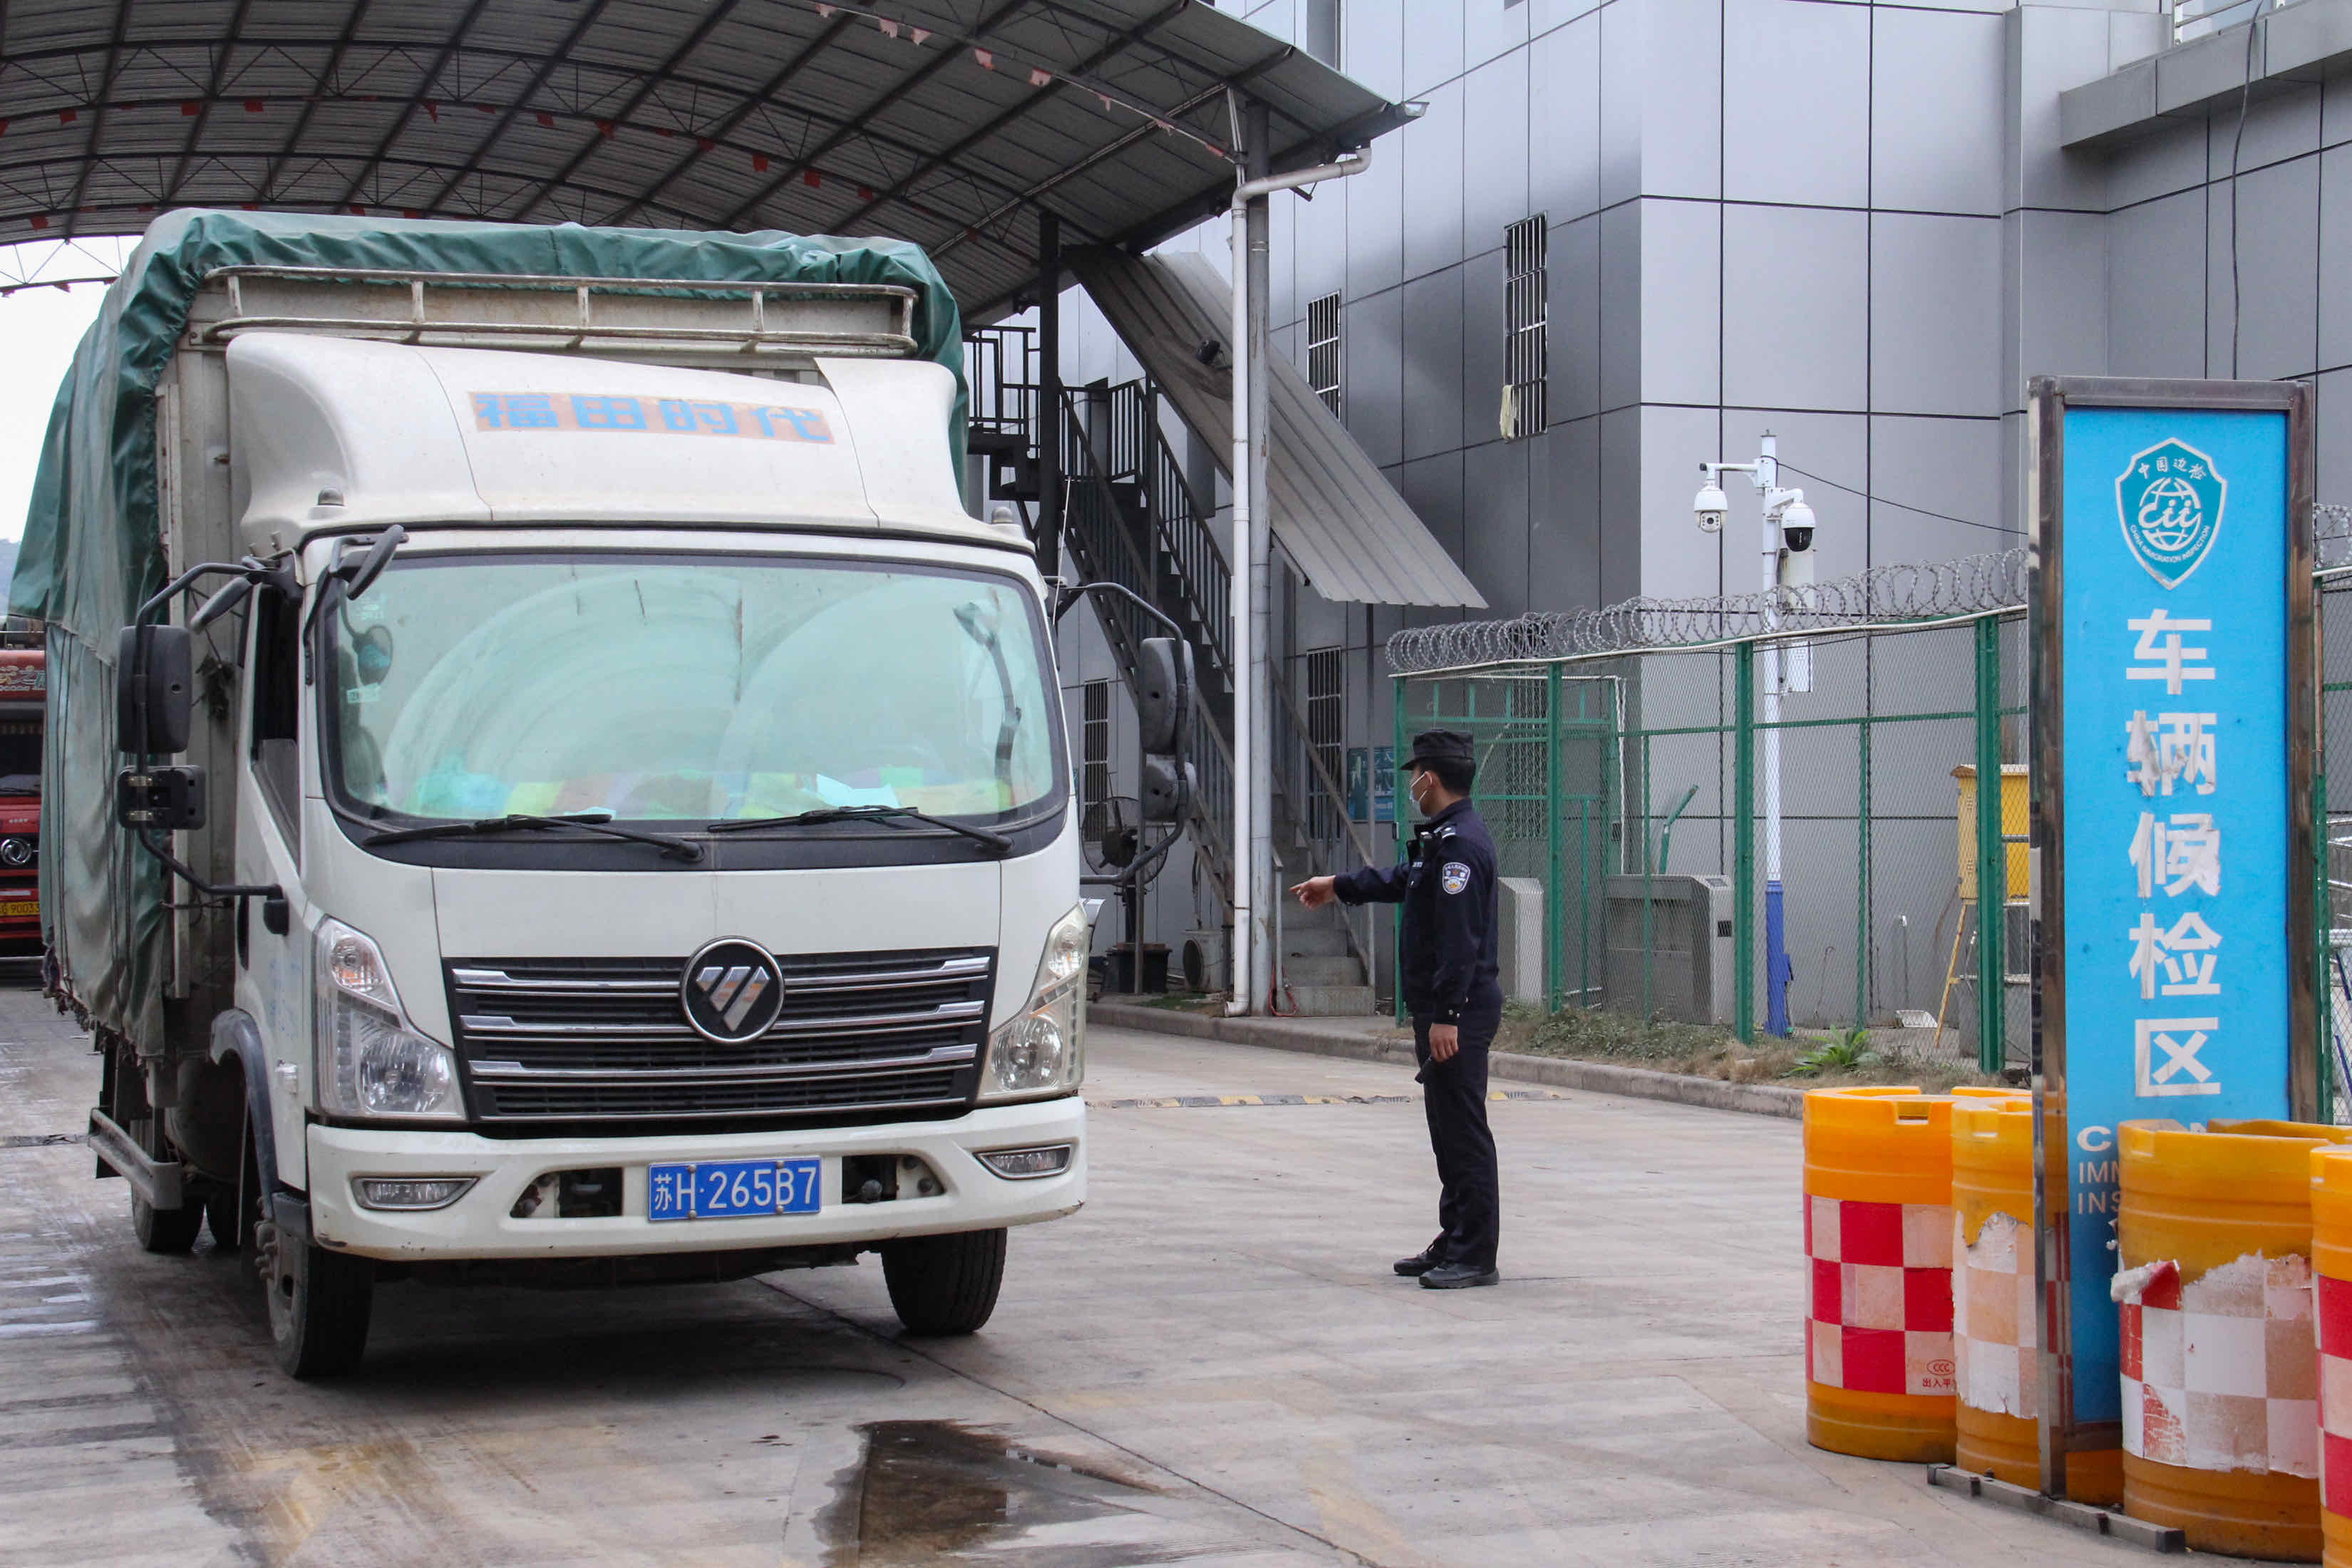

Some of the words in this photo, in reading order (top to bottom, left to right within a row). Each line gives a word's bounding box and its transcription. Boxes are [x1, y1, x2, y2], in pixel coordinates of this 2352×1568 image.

[475, 394, 830, 442] 福田时代
[2137, 456, 2207, 480] 中国边检
[2126, 609, 2222, 1098] 车辆候检区
[1922, 1378, 1957, 1389] 出入平
